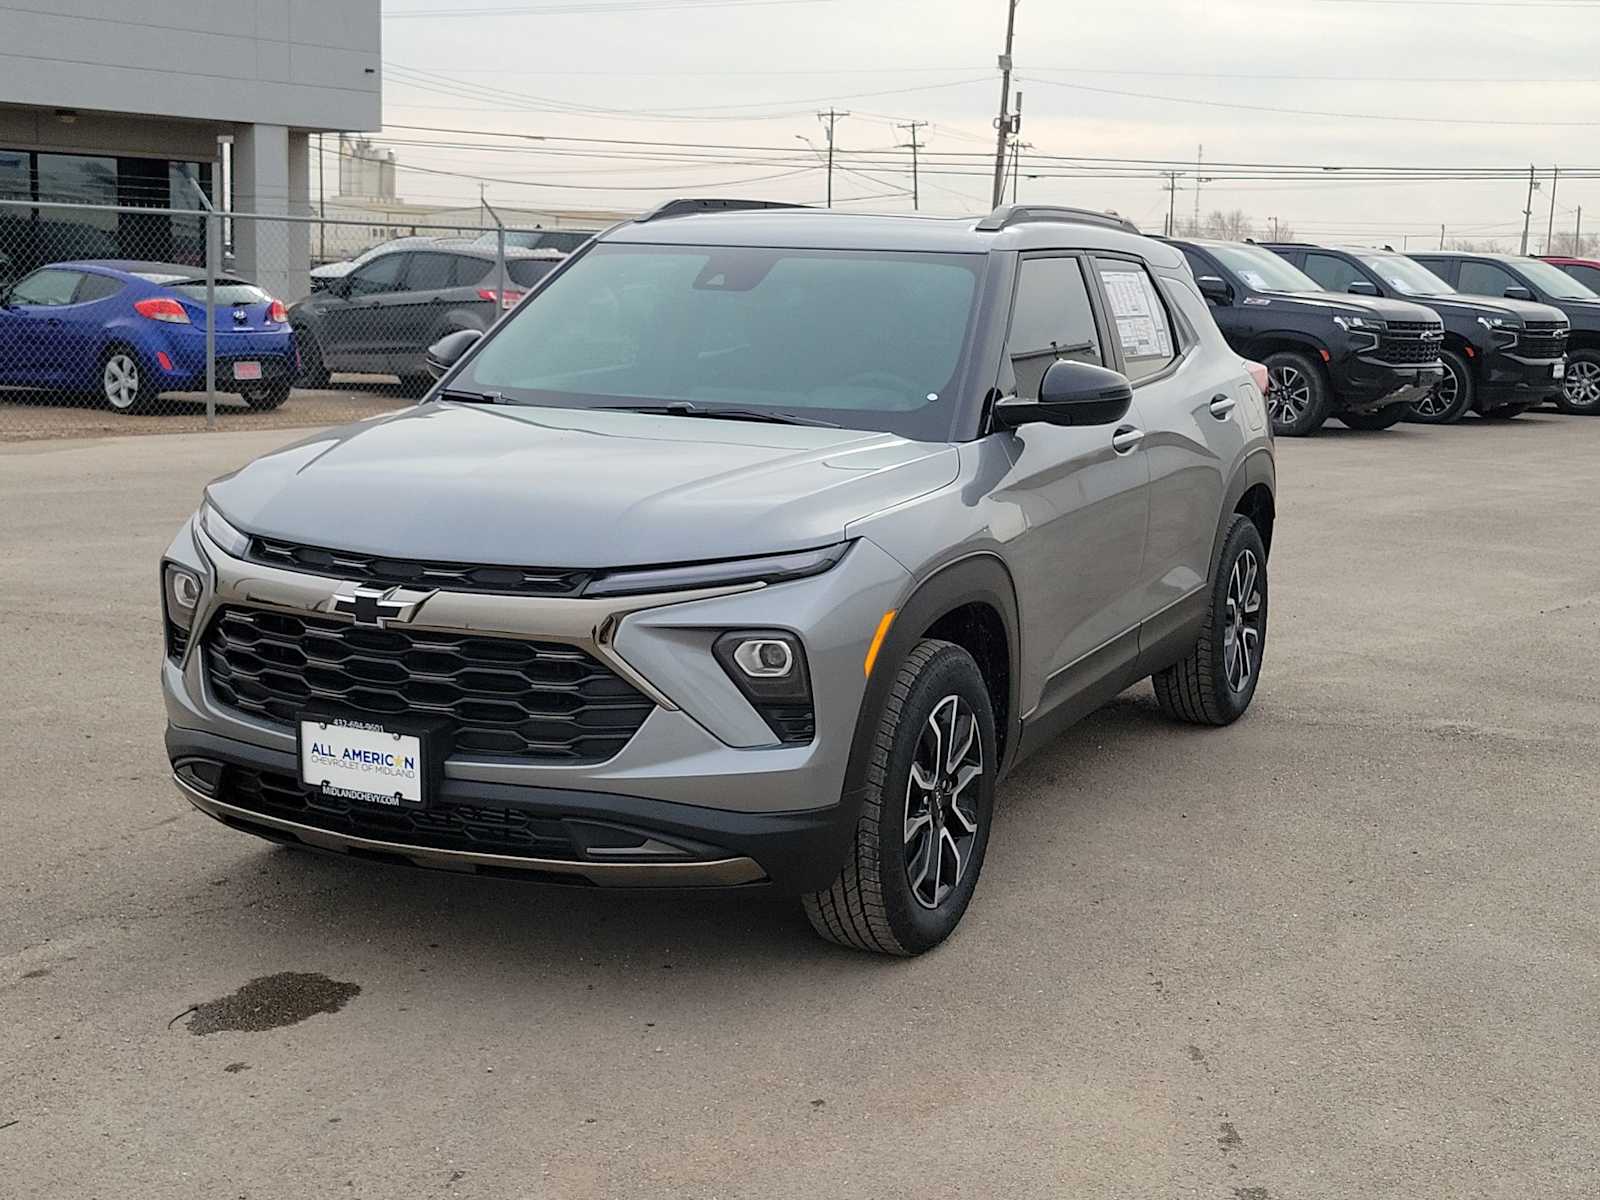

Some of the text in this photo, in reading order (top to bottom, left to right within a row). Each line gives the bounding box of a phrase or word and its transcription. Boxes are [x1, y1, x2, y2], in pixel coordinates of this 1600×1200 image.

[311, 742, 336, 757] ALL
[311, 754, 415, 779] CHEVROLET OF MIDLAND
[322, 786, 400, 806] MIDLANDCHEVY.COM
